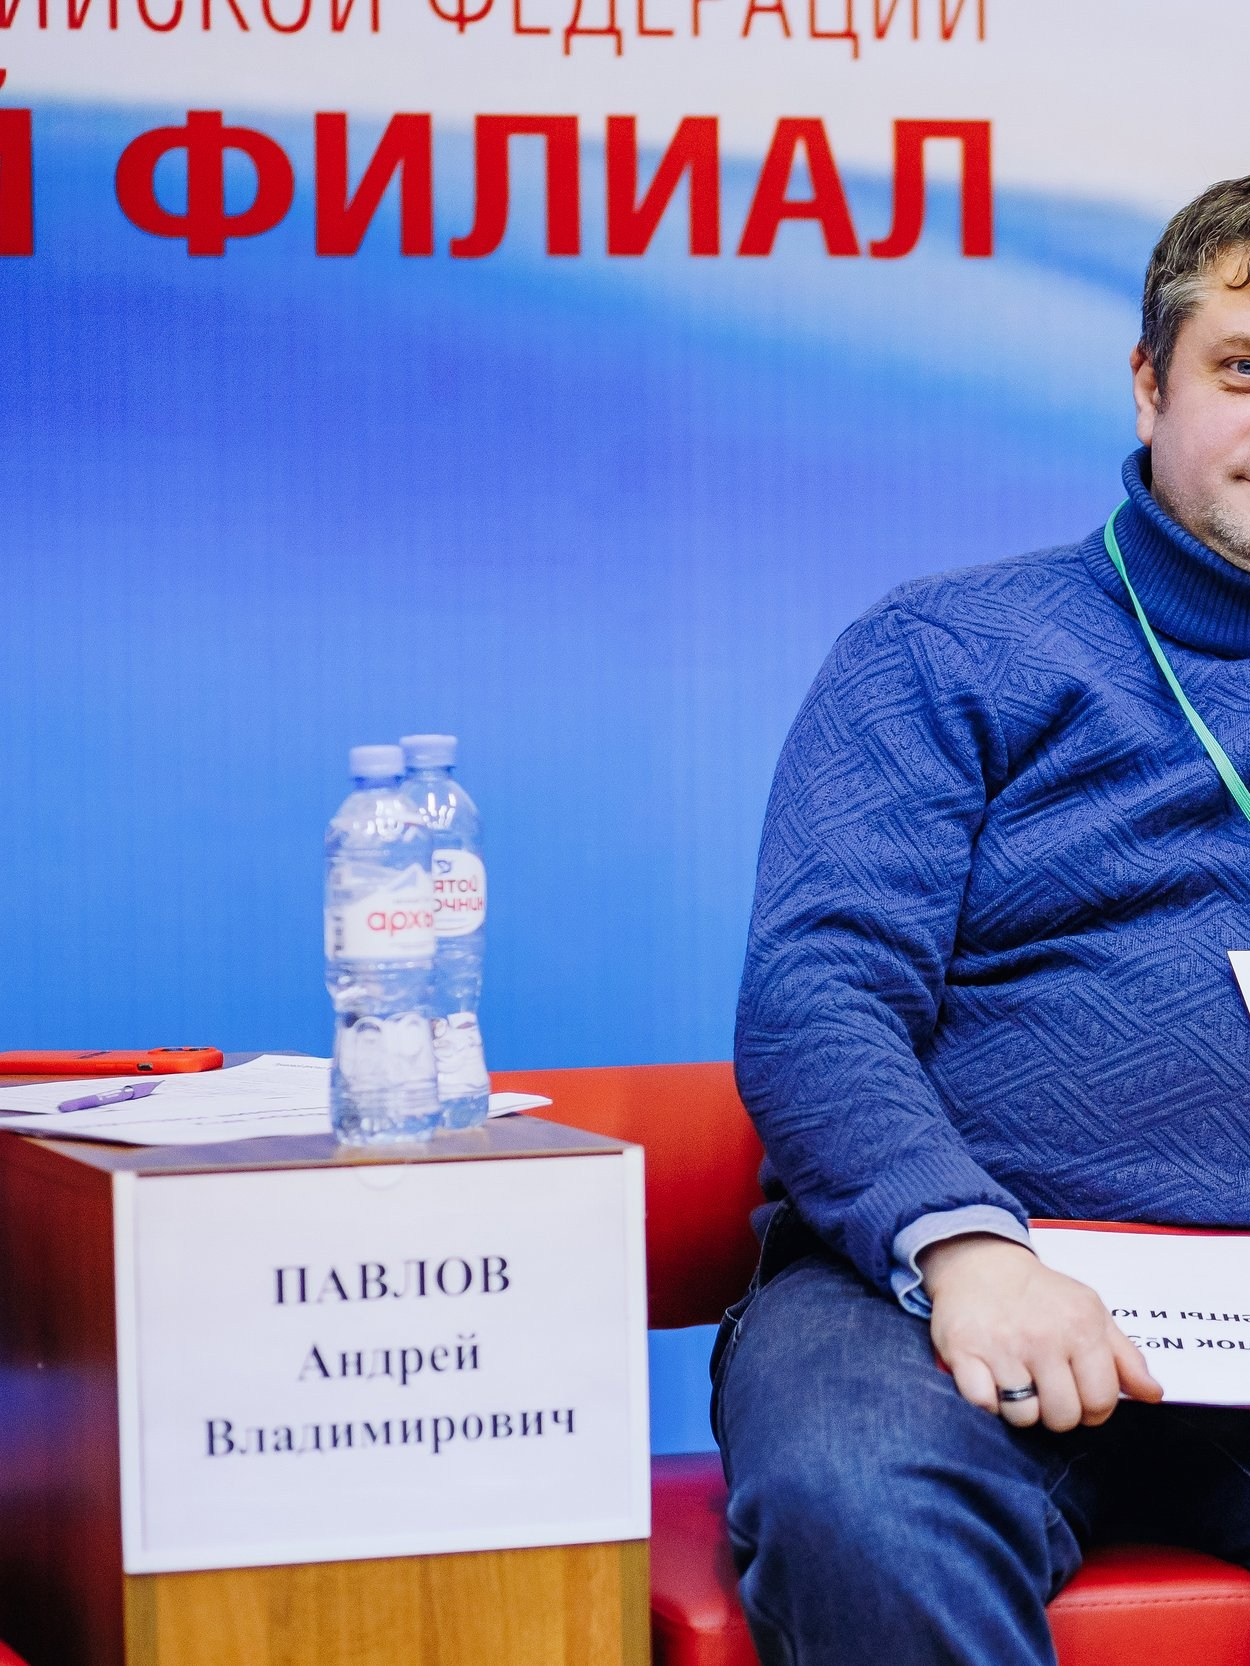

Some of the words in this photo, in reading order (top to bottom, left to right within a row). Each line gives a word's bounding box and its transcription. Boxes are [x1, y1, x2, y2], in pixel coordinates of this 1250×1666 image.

[115, 109, 995, 260] ФИЛИАЛ
[273, 1256, 512, 1306] ПАВЛОВ
[1150, 1310, 1168, 1319] и
[298, 1334, 481, 1386] Андрей
[205, 1408, 576, 1457] Владимирович
